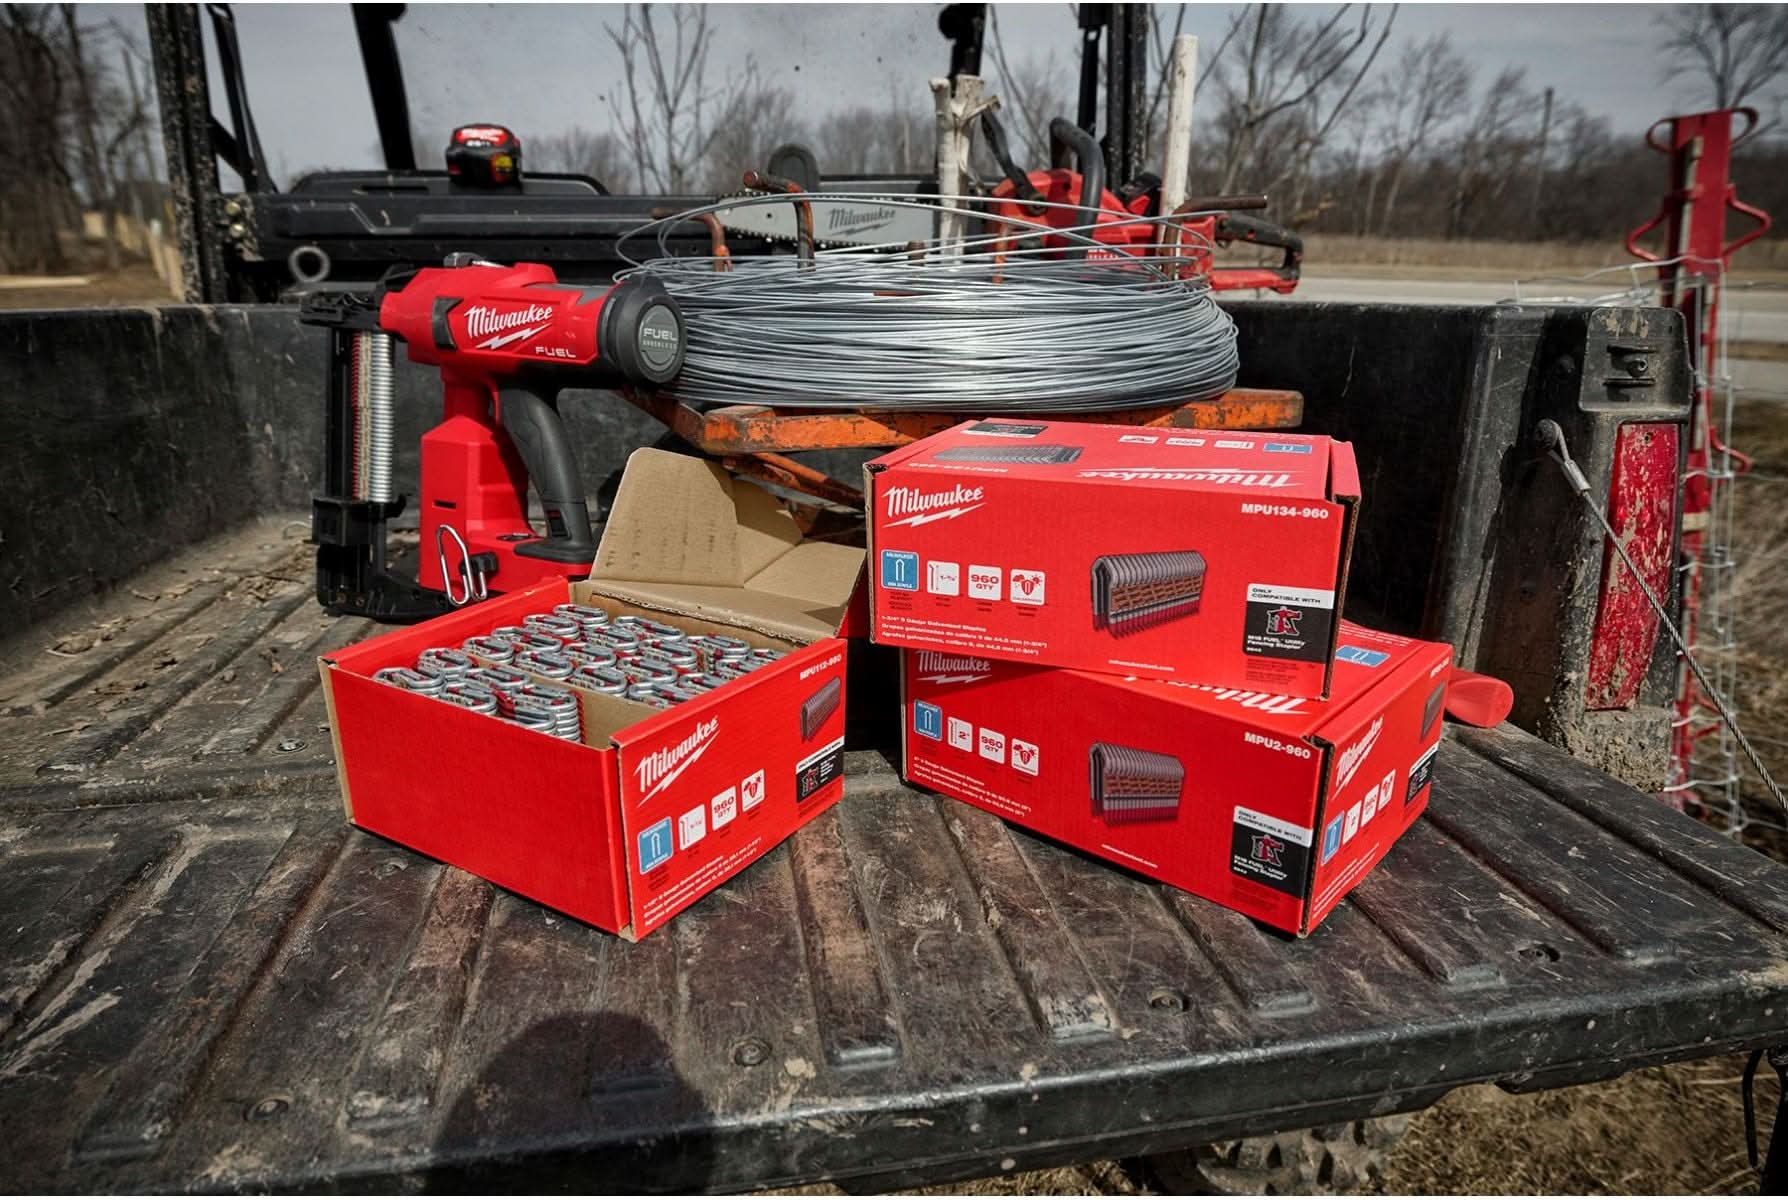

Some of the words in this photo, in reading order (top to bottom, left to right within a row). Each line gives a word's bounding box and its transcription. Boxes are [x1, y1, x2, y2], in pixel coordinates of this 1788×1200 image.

[828, 207, 896, 230] Milwaukee
[464, 303, 552, 338] Milwaukee
[643, 327, 678, 341] FUEL
[535, 346, 576, 358] FUEL
[1076, 471, 1303, 489] Milwaukee
[882, 484, 984, 517] Milwaukee
[1241, 503, 1329, 520] MPU134-960
[970, 574, 999, 585] 960
[1252, 593, 1300, 602] COMPATIBLE
[915, 650, 991, 672] Milwaukee
[981, 735, 1003, 749] 960
[1244, 731, 1311, 760] MPU2-960
[633, 715, 719, 793] Milwaukee
[713, 796, 734, 813] 960
[718, 806, 732, 818] QTY
